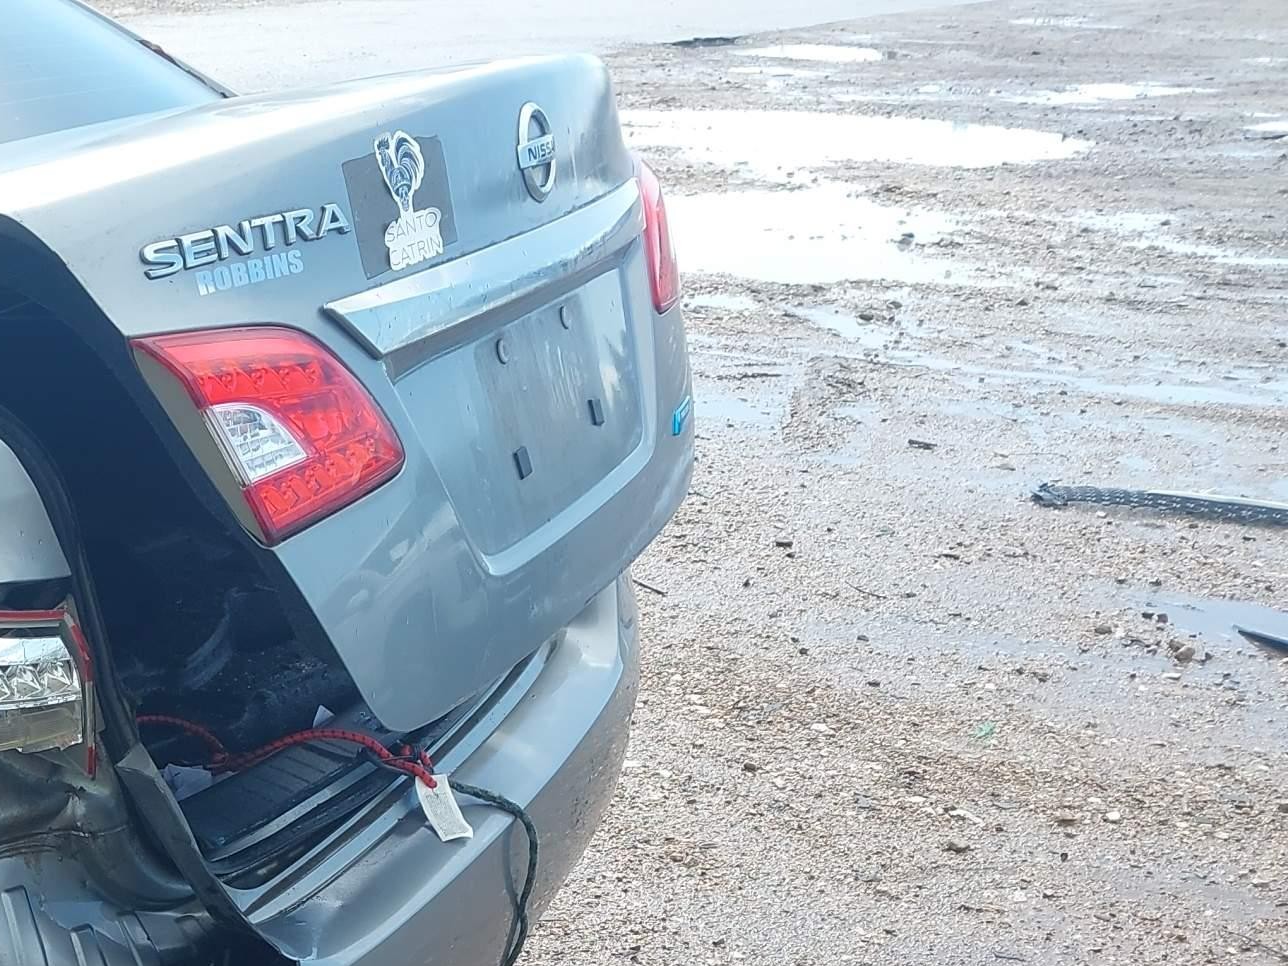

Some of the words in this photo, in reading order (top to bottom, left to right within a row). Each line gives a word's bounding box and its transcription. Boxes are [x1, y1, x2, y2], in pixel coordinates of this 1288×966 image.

[140, 202, 353, 280] SENTRA
[386, 210, 438, 243] SANTO
[390, 236, 442, 267] CATRIN
[194, 249, 305, 297] ROBBINS
